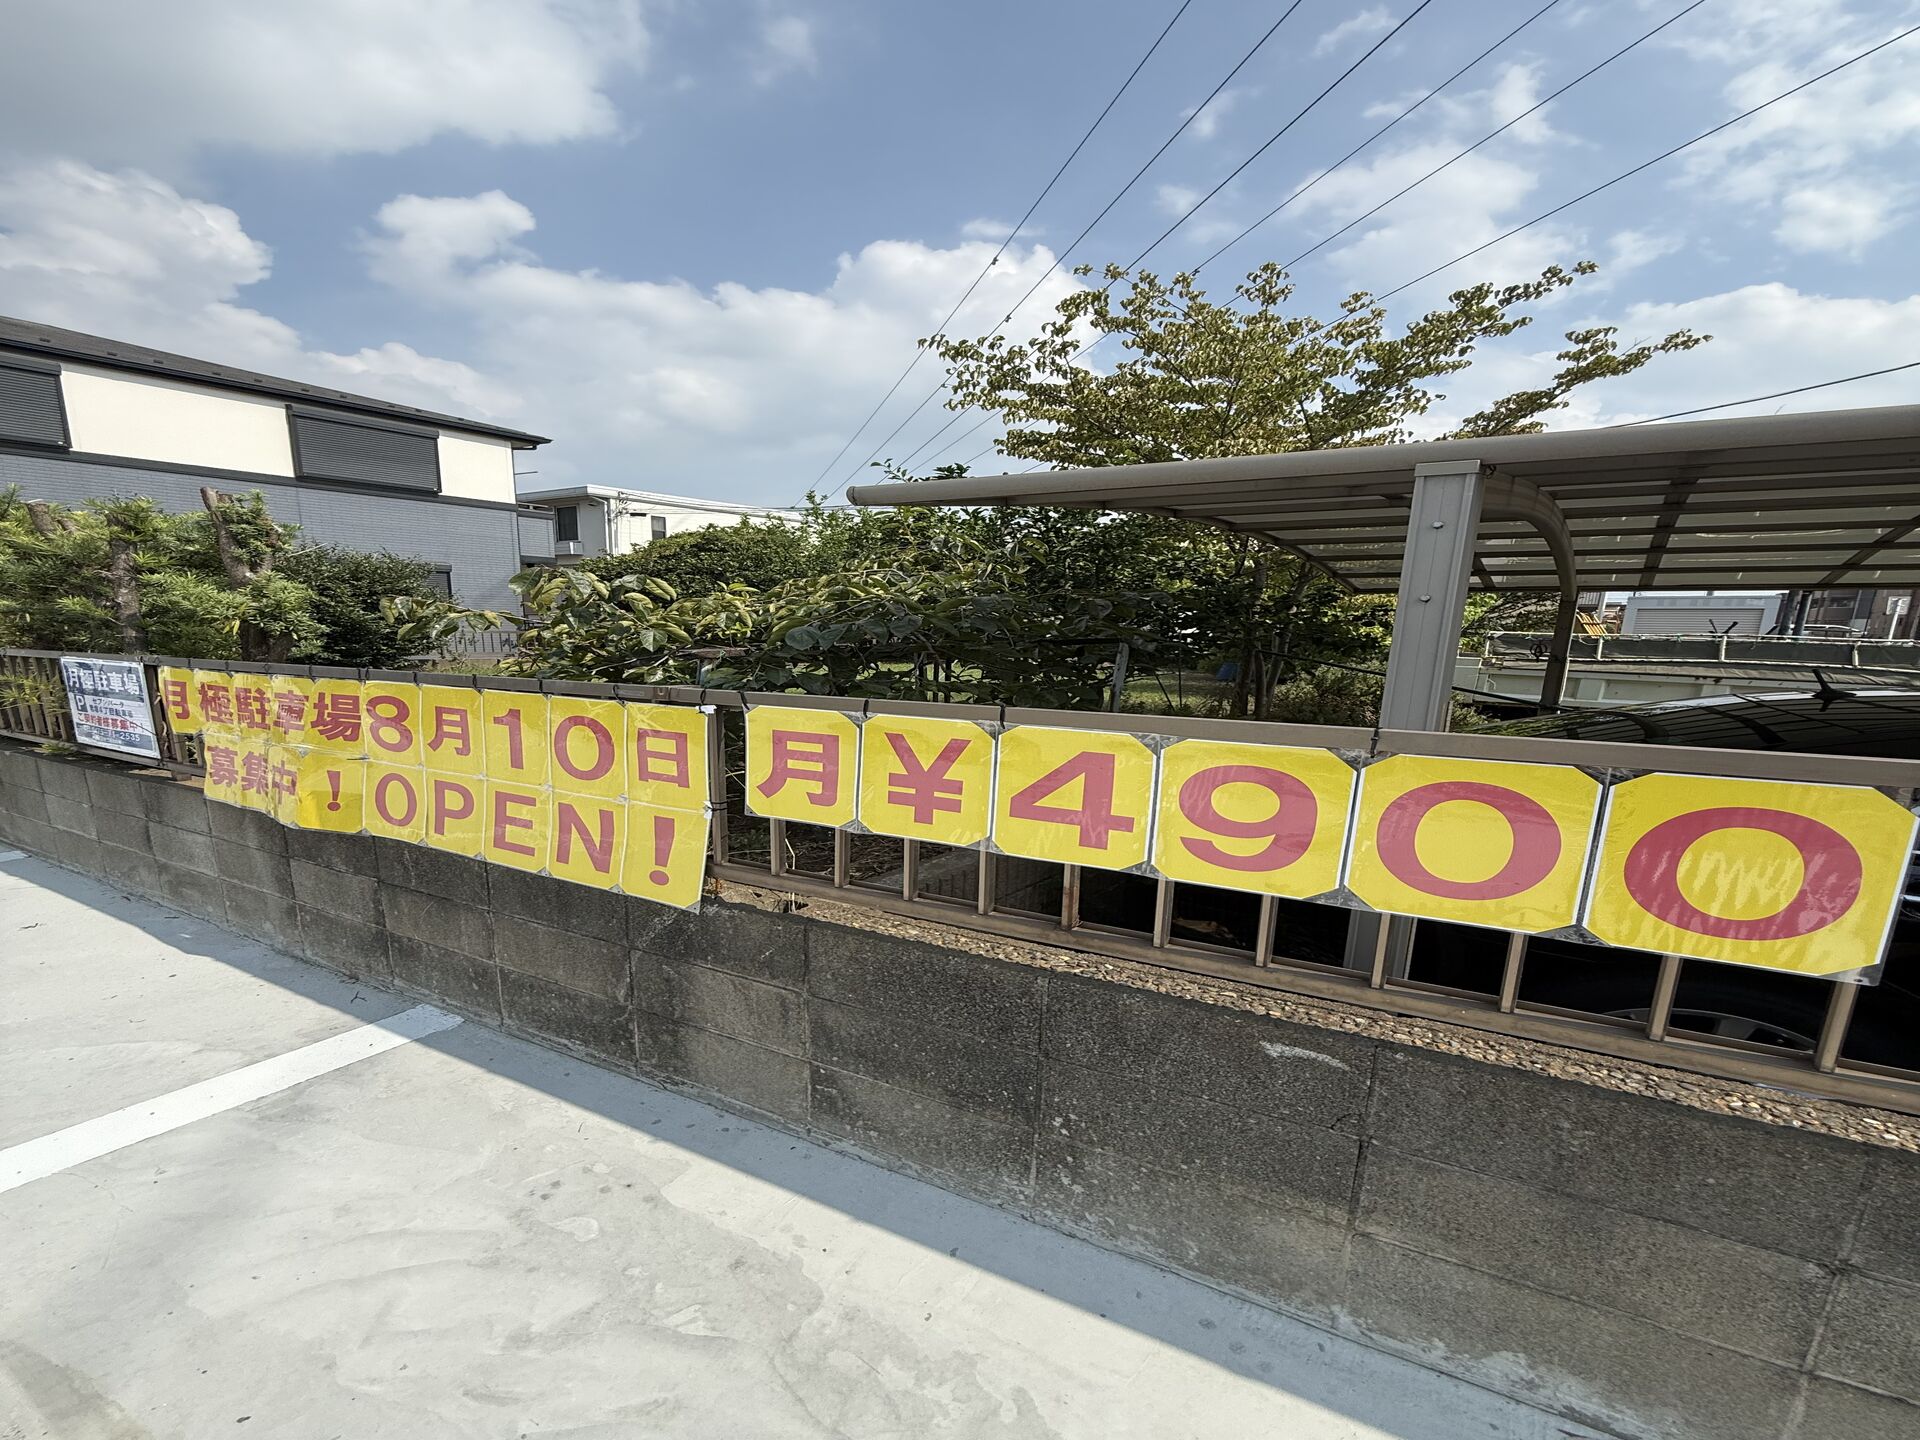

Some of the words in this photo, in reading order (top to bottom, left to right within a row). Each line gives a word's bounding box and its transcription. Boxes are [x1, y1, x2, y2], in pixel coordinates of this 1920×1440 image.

[68, 668, 140, 695] 月極駐車場
[75, 696, 86, 711] P
[164, 679, 362, 742] 月極駐車場
[374, 772, 676, 886] OPEN!
